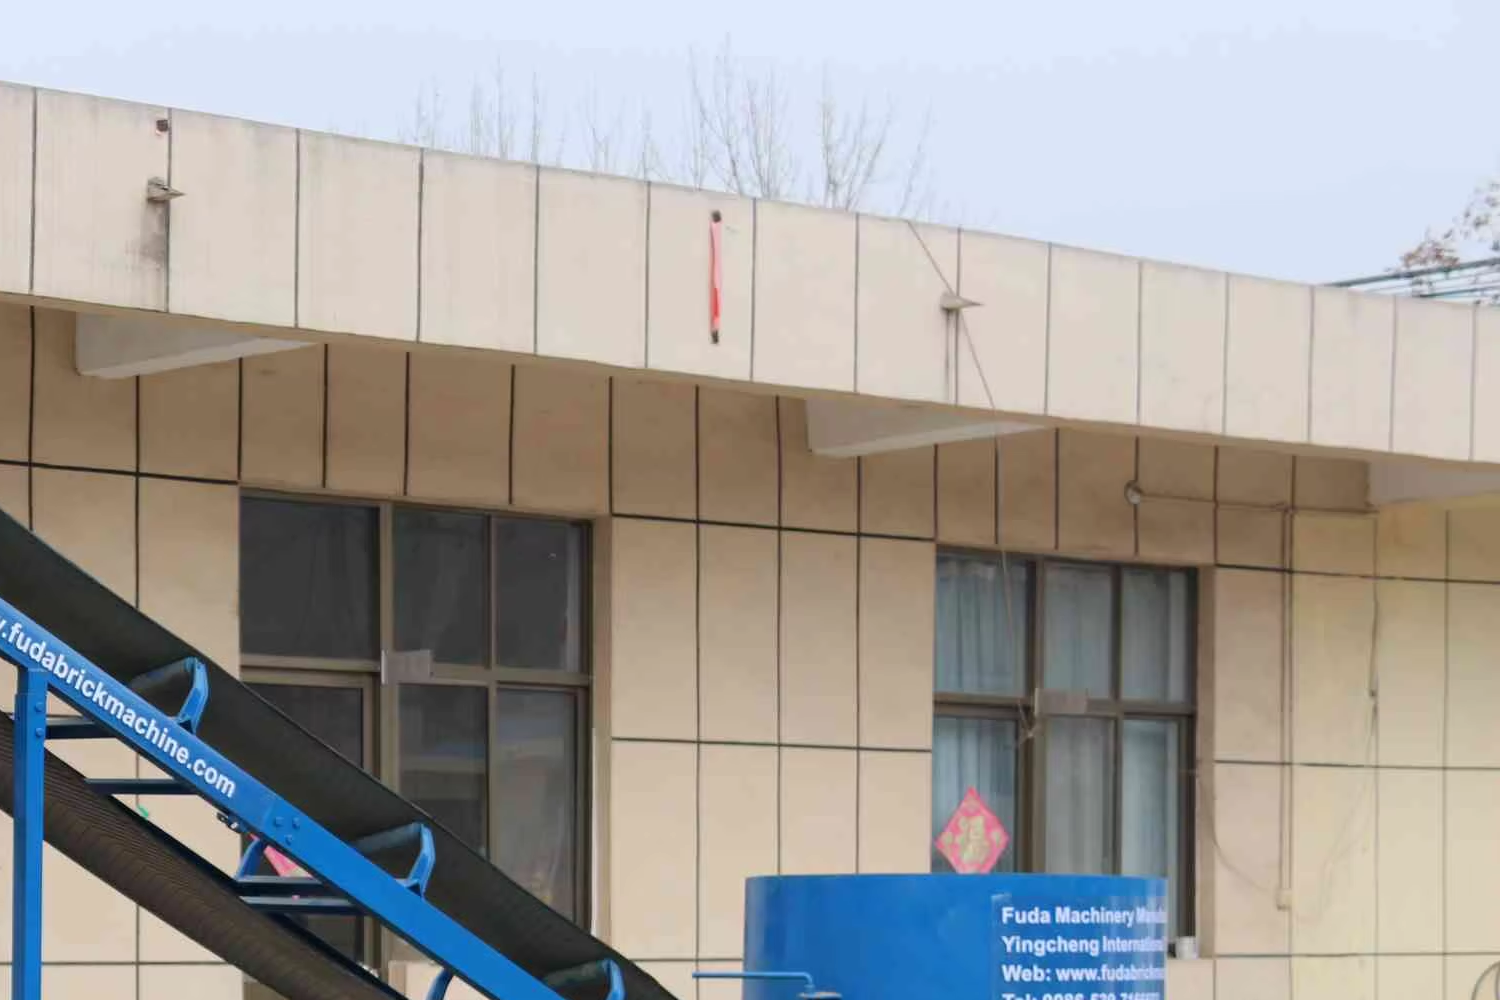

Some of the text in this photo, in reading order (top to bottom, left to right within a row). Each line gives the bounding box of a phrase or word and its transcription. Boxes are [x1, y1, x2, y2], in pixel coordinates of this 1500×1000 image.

[1001, 906, 1051, 924] Fuda
[1055, 906, 1134, 928] Machinery
[1001, 935, 1100, 957] Yingcheng
[1001, 964, 1051, 982] Web:
